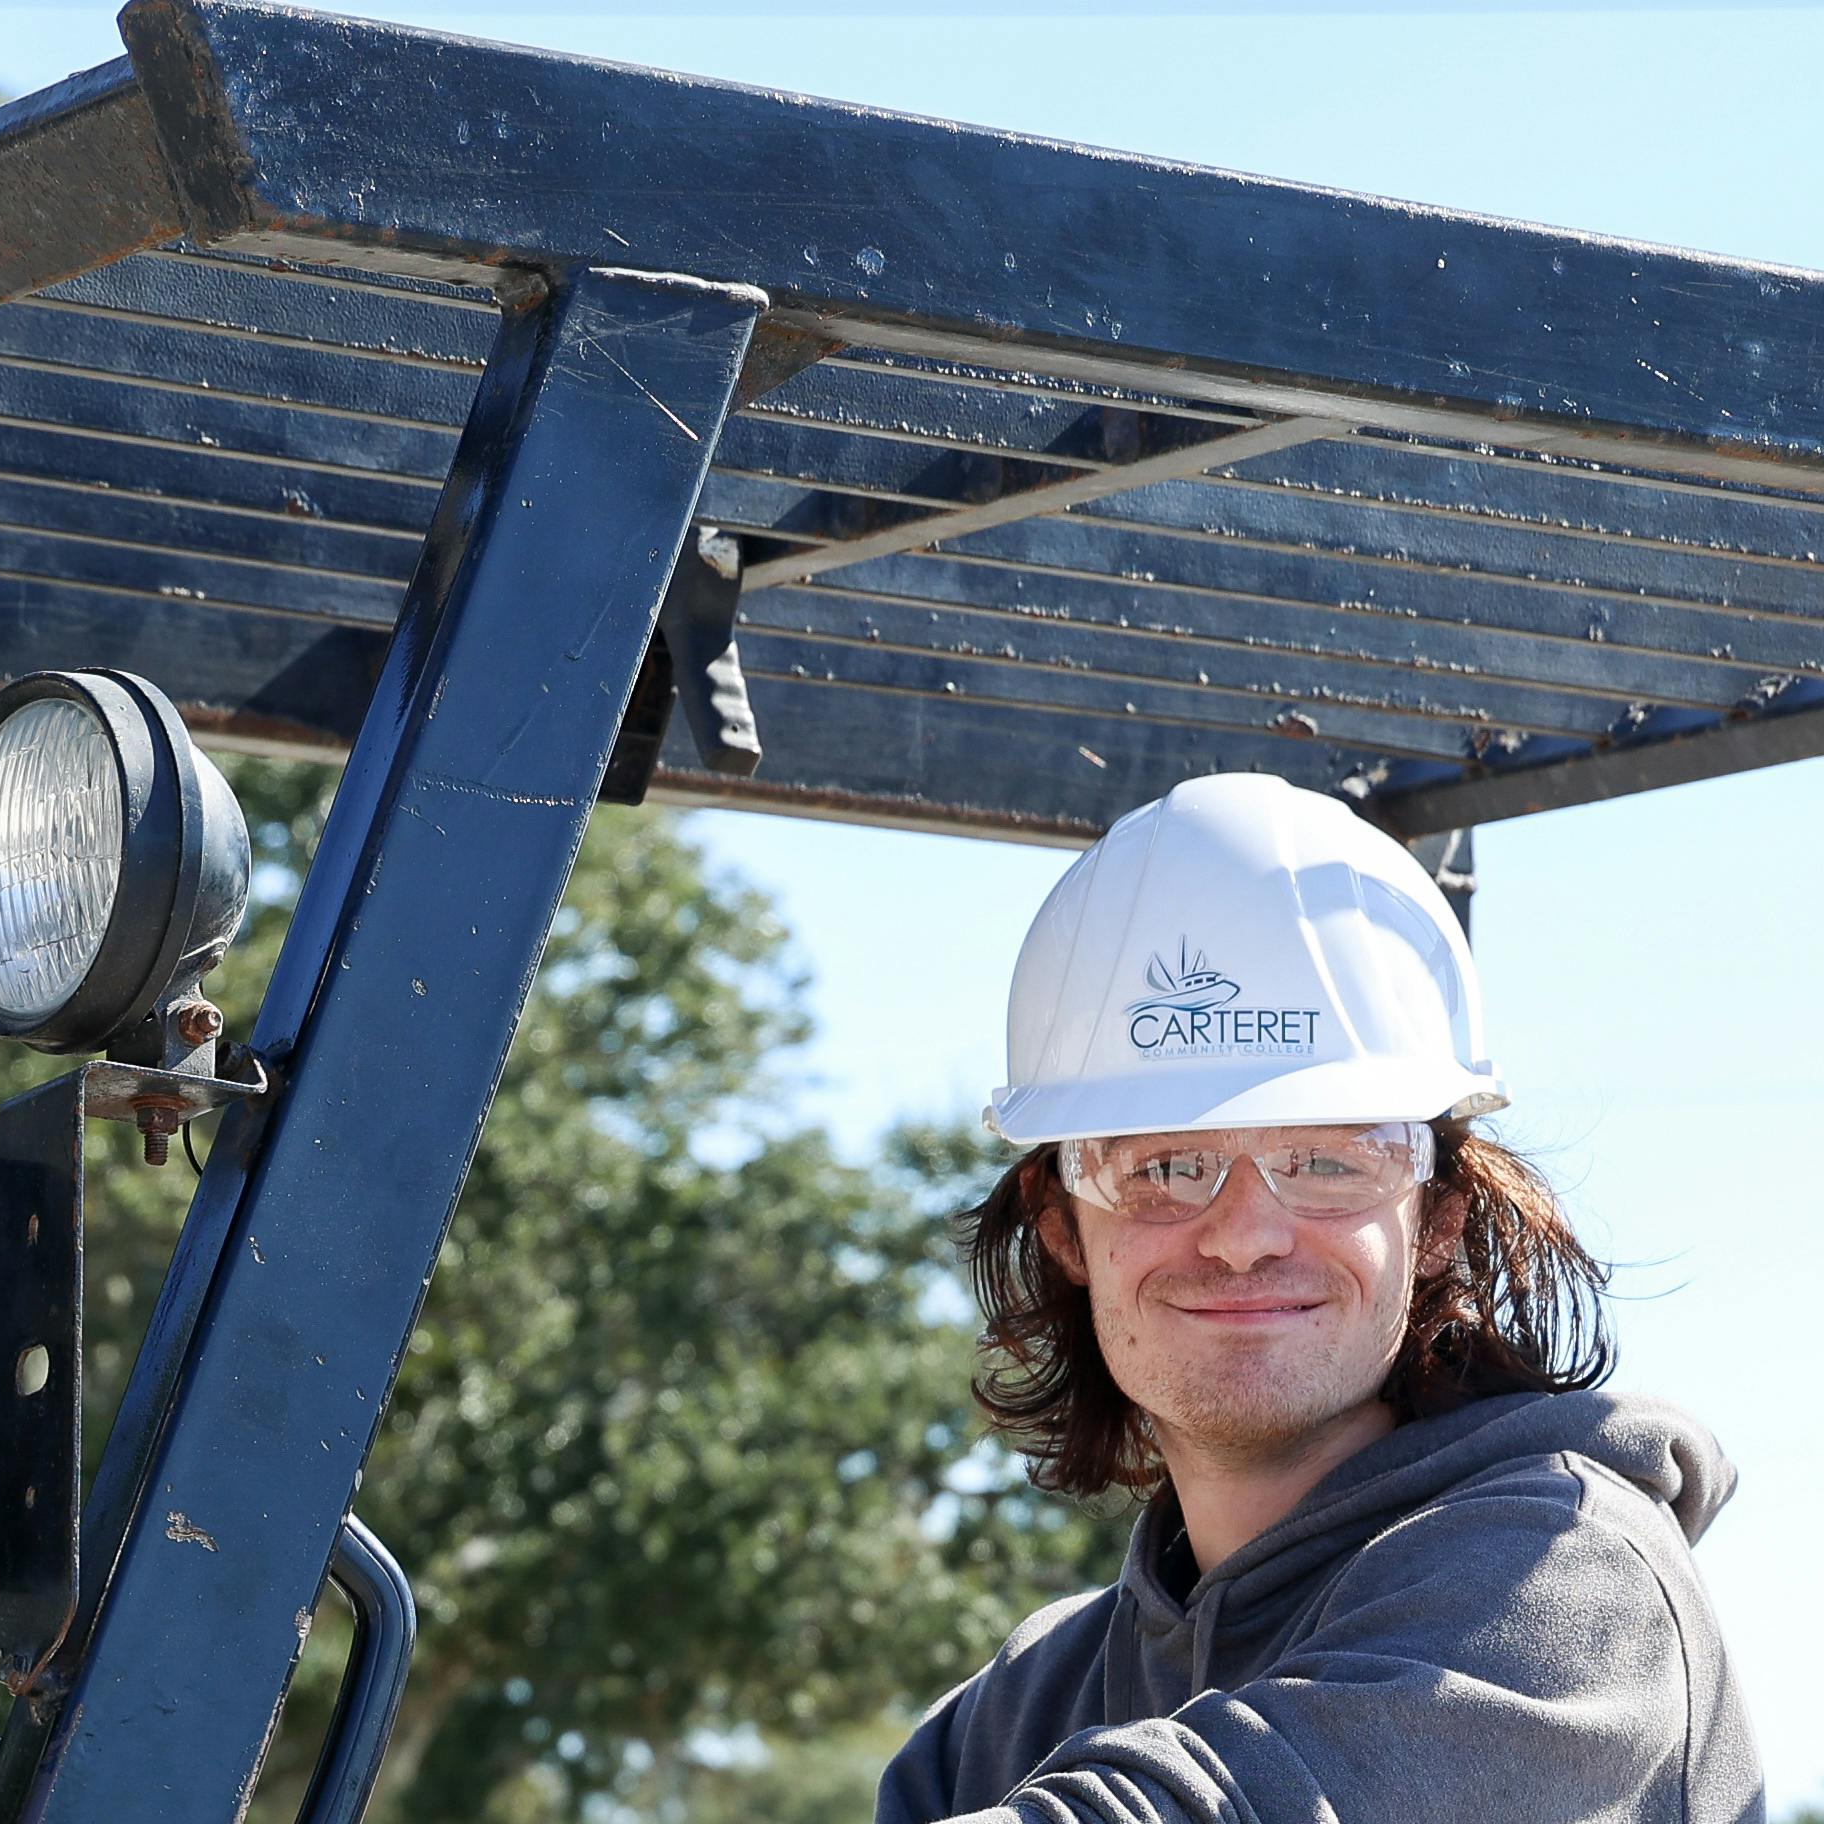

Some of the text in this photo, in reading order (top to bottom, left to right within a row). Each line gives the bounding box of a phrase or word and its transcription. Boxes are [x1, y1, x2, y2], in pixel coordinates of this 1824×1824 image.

[1130, 1010, 1320, 1049] CARTERET
[1142, 1044, 1314, 1058] COMMUNITY COLLEGE
